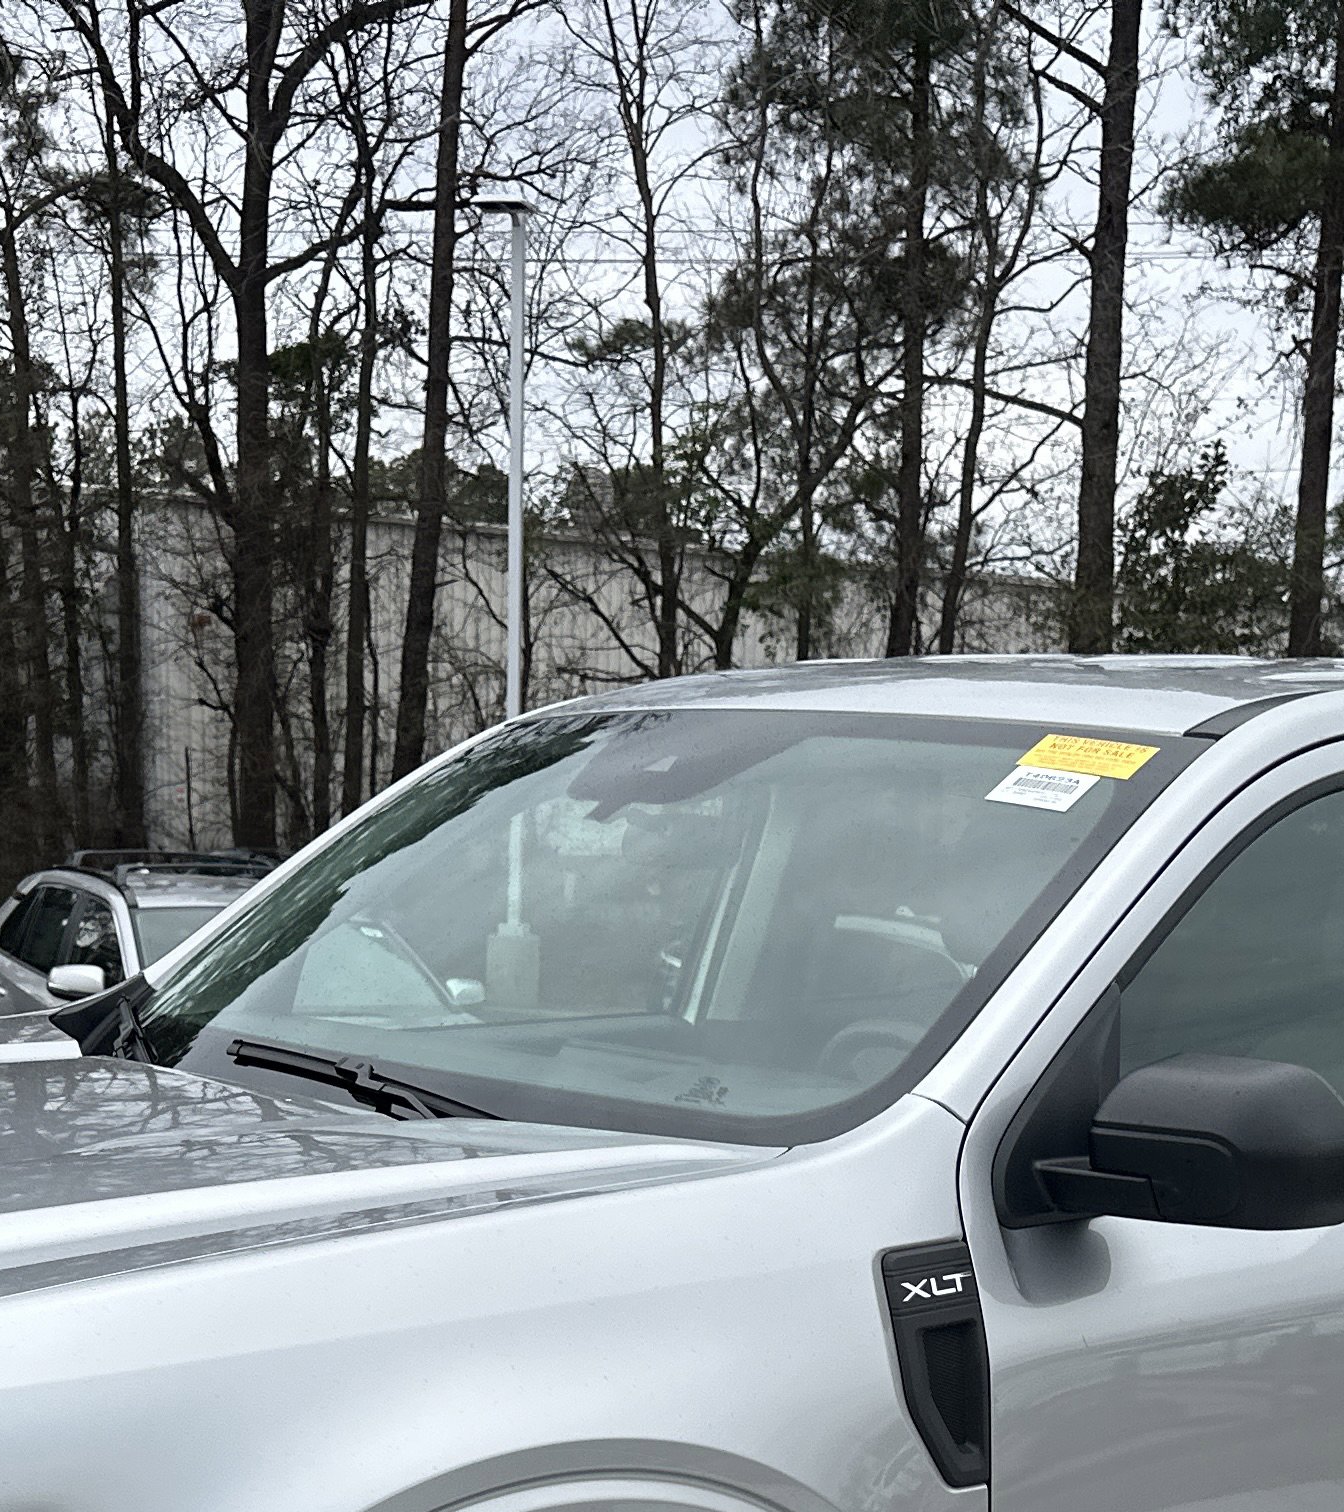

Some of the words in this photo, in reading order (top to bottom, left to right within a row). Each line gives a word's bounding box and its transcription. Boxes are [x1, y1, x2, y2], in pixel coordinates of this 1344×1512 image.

[1077, 746, 1102, 754] FOR
[1103, 749, 1135, 758] SALE
[900, 1271, 972, 1302] XLT
